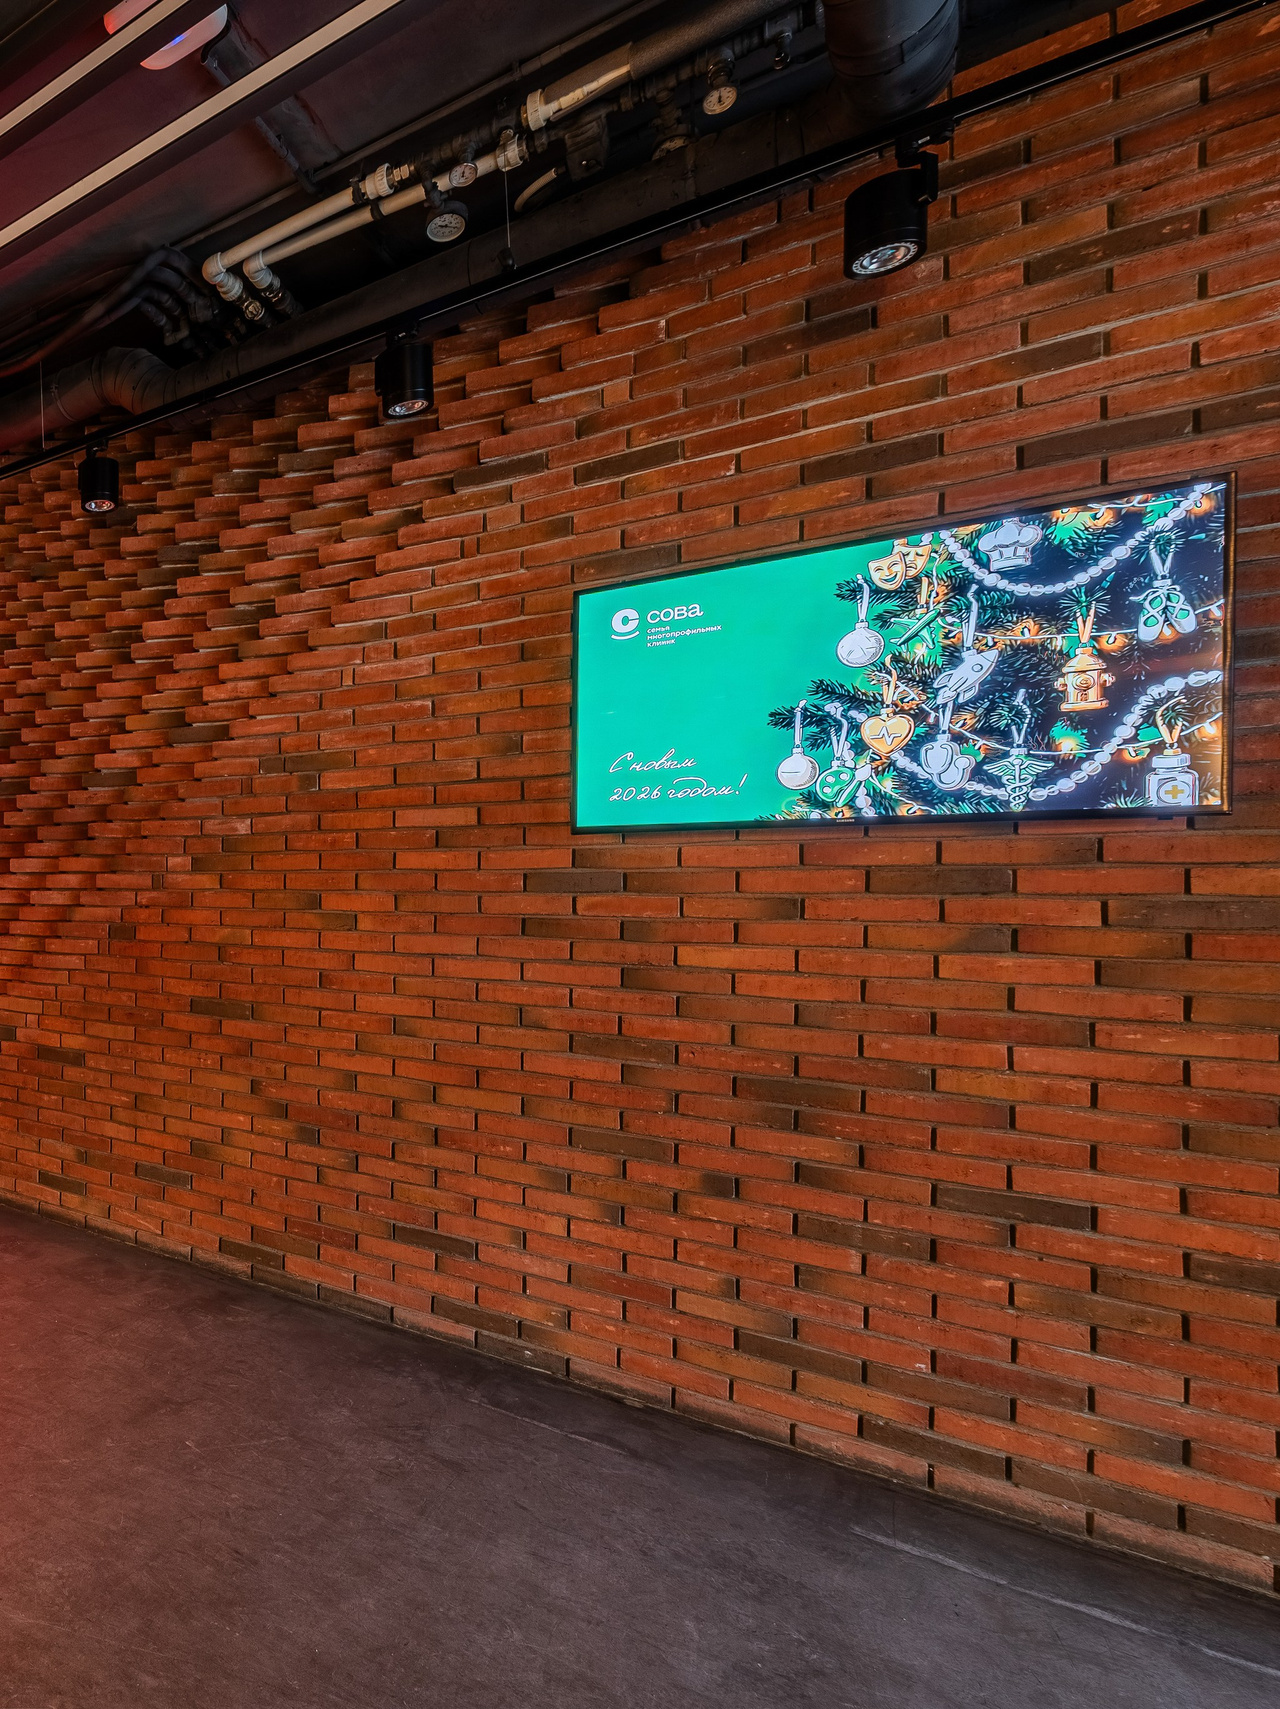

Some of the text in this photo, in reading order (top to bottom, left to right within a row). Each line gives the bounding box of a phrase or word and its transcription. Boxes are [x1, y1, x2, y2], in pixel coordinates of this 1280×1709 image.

[646, 625, 671, 634] семья
[646, 624, 722, 641] многопрофильных
[646, 638, 676, 648] клиник
[608, 748, 697, 773] С новым
[608, 773, 748, 802] 2026 годом!
